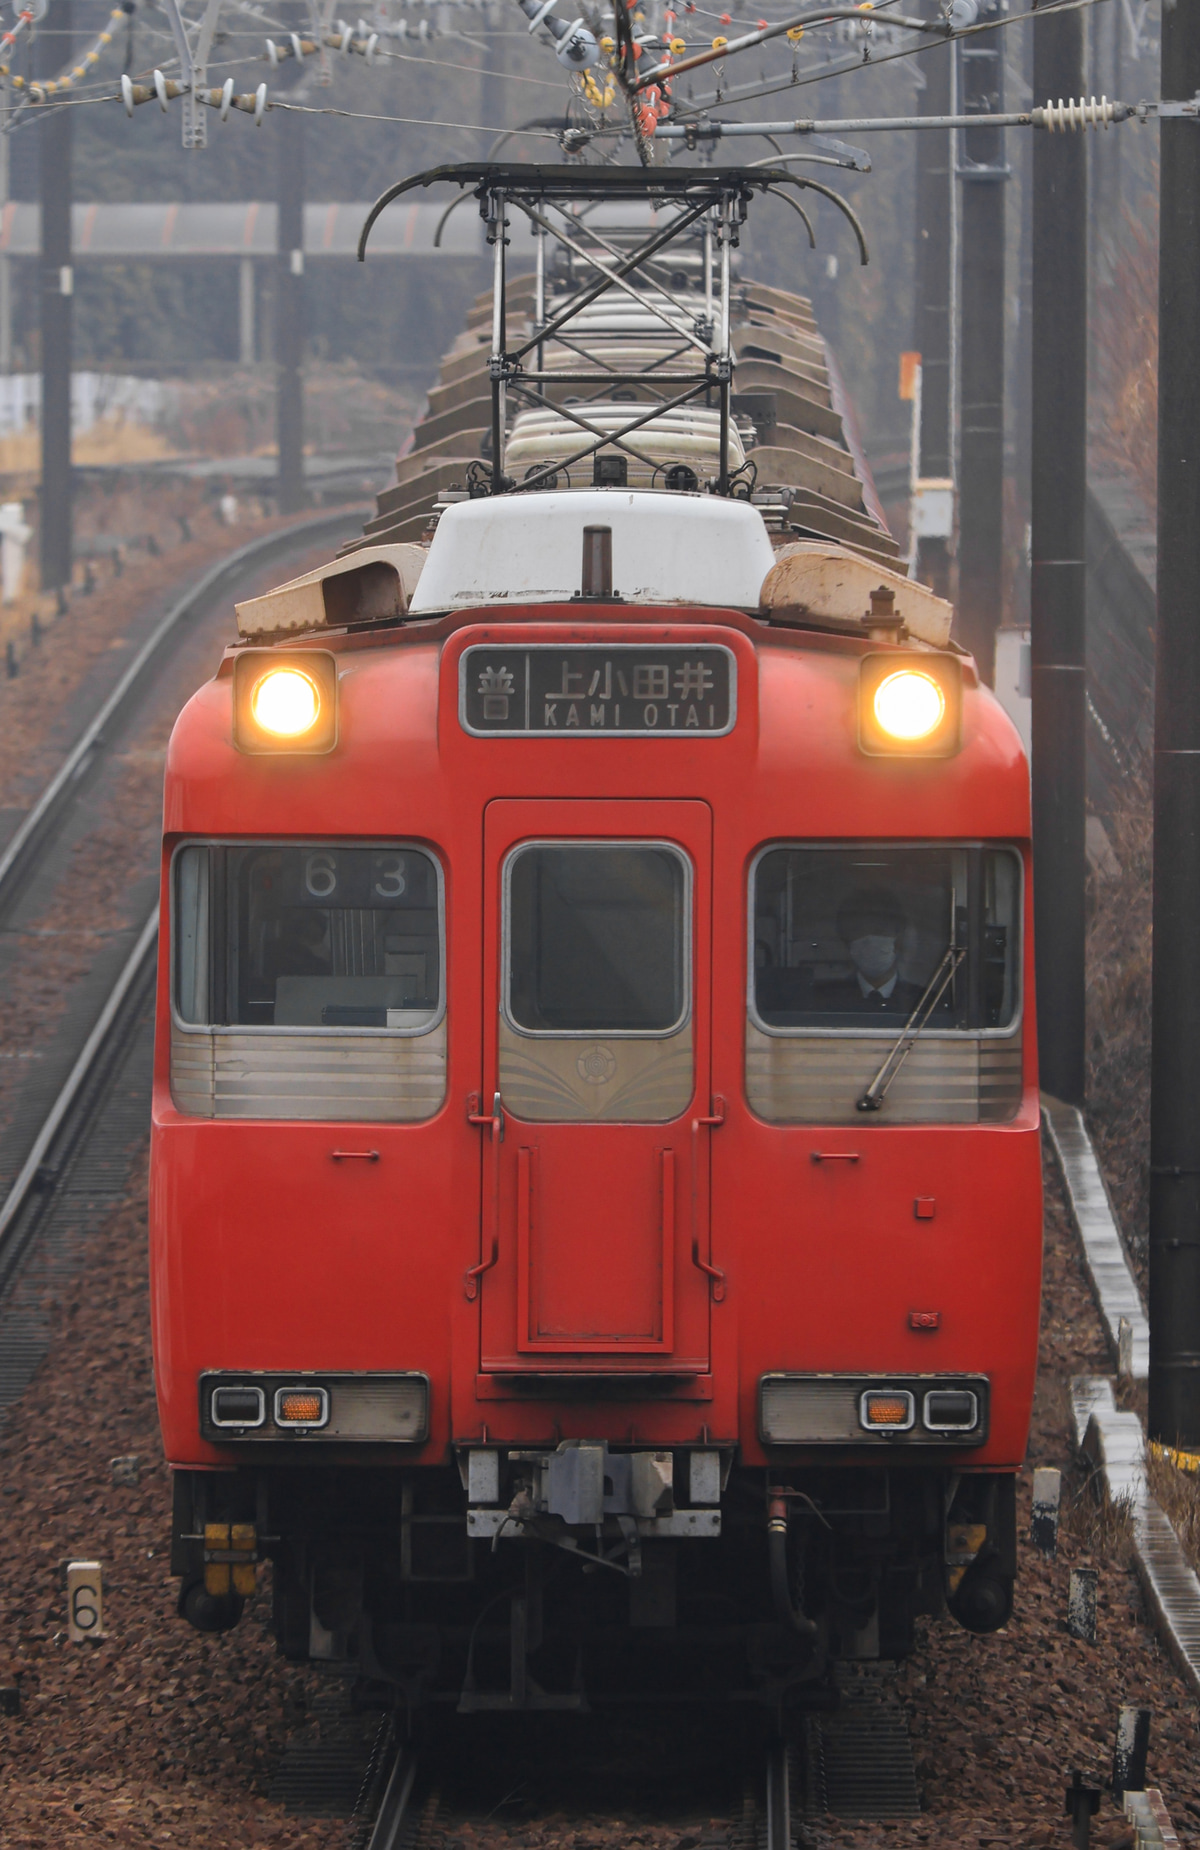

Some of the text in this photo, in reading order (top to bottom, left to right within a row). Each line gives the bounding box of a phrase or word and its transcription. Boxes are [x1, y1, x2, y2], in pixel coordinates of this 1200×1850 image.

[478, 666, 515, 720] 普
[545, 661, 714, 700] 上小田井
[544, 704, 715, 727] KAMI OTAI
[72, 1585, 98, 1630] 6
